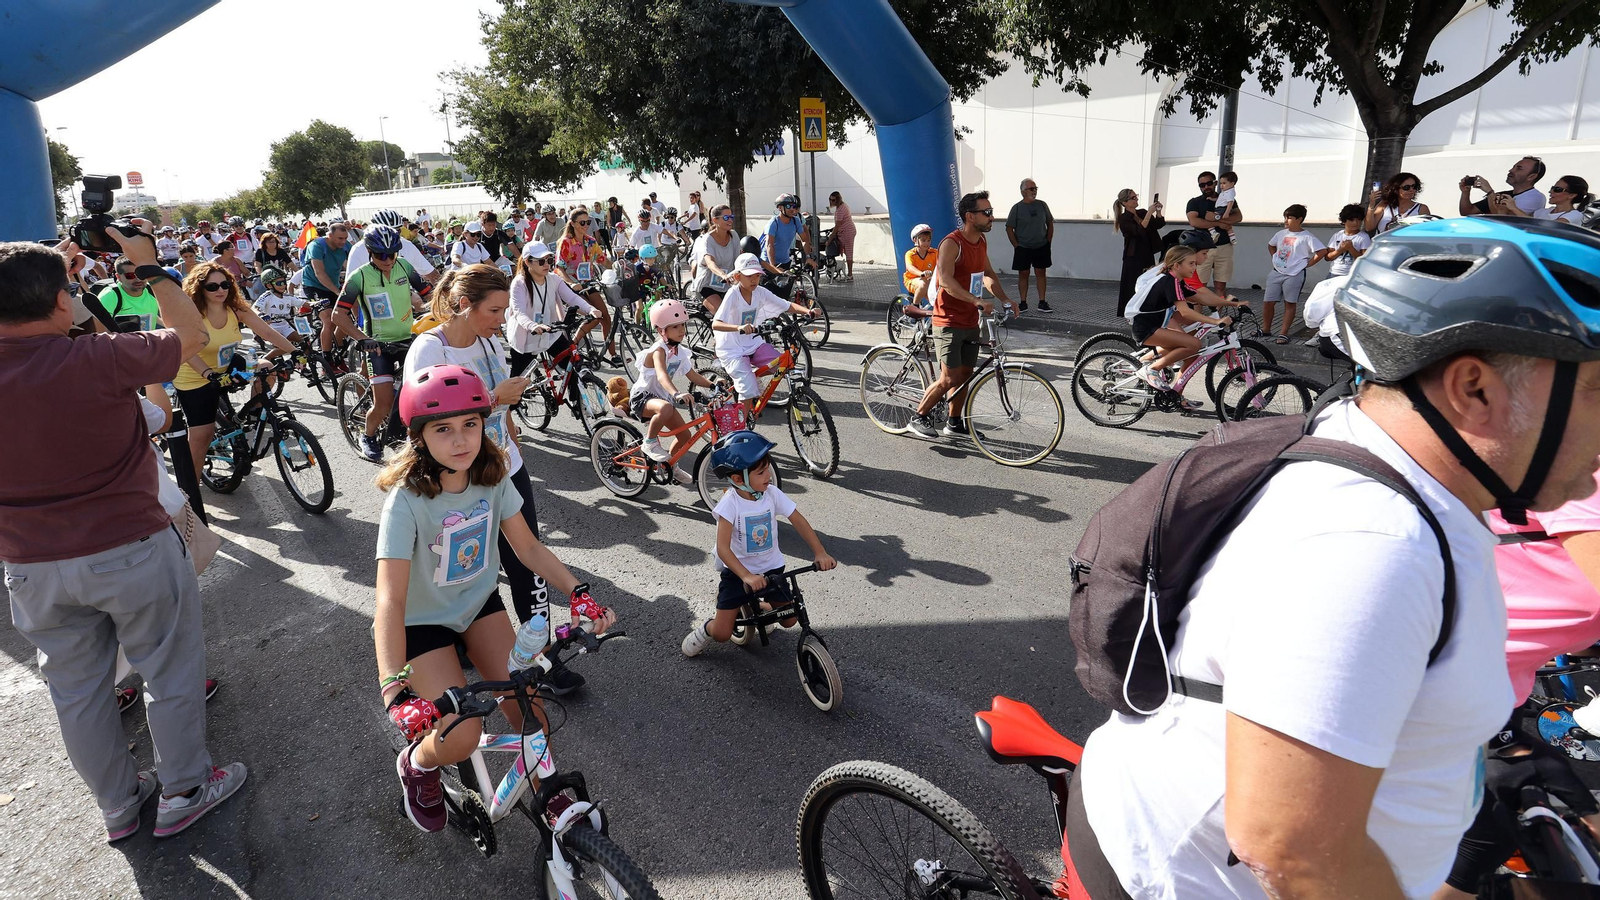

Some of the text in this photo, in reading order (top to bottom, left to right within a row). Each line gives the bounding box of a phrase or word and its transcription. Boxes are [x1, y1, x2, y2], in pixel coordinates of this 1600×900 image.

[804, 141, 824, 149] PEATONES
[205, 783, 224, 802] N
[497, 765, 520, 805] NEON
